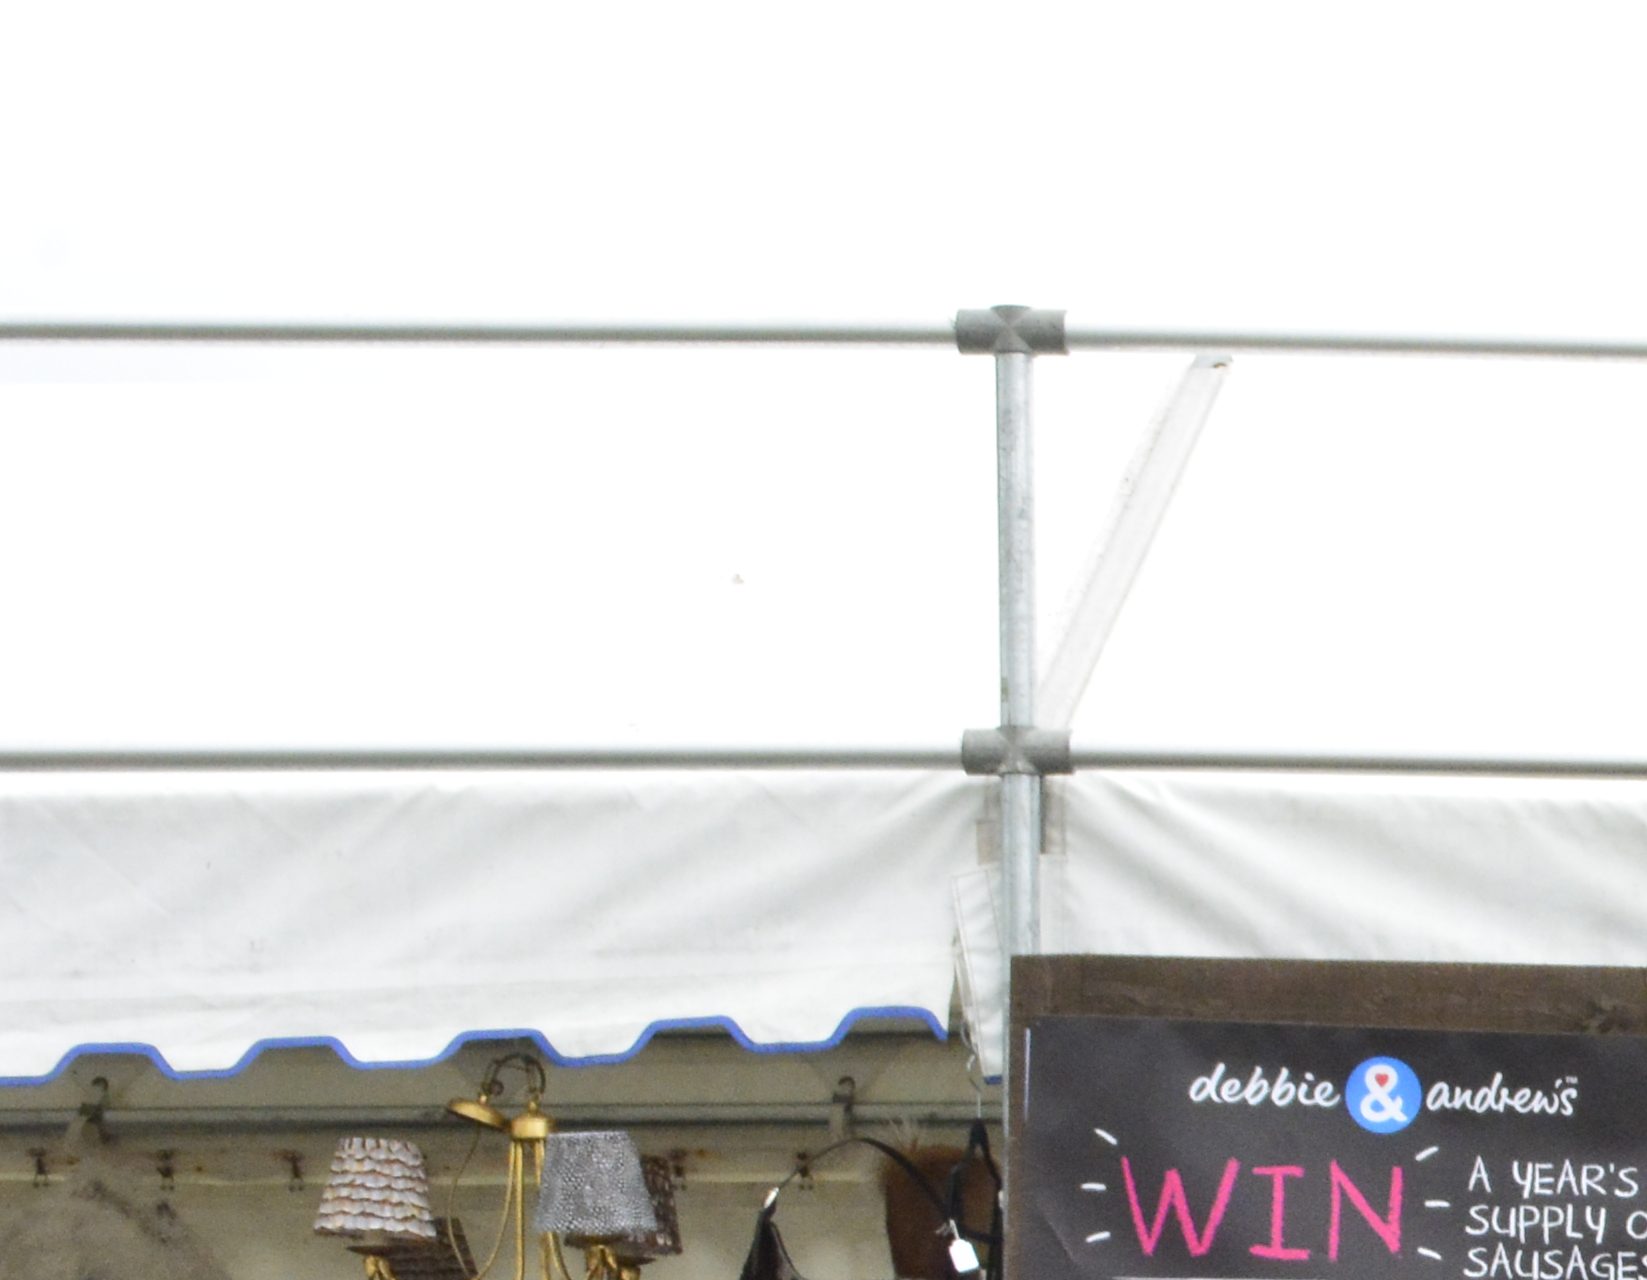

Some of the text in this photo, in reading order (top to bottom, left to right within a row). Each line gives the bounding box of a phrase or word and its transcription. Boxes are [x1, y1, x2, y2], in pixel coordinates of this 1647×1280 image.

[1188, 1061, 1578, 1128] debbie & andrew's
[1468, 1155, 1639, 1199] A YEAR'S
[1122, 1157, 1404, 1261] WIN
[1465, 1203, 1607, 1245] SUPPLY
